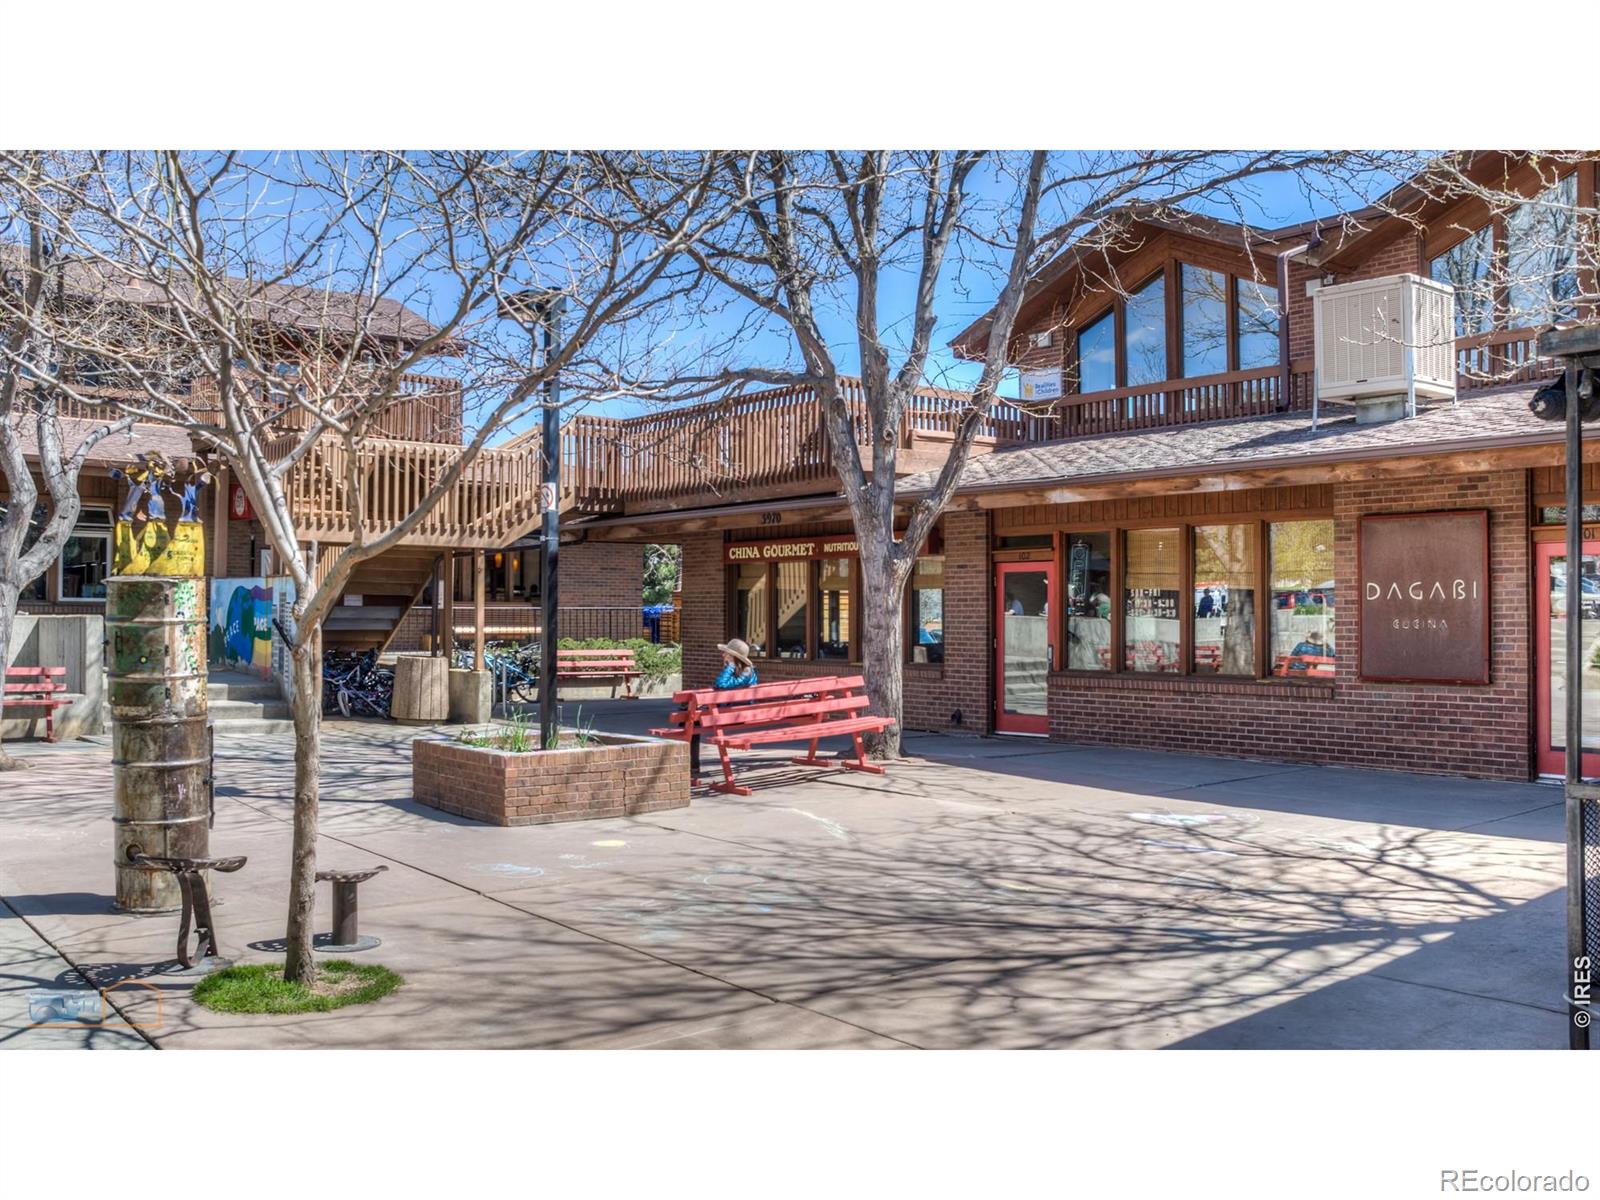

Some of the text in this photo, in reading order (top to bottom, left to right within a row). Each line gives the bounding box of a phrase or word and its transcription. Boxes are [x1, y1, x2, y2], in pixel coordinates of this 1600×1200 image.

[1583, 528, 1595, 540] 01
[729, 541, 859, 559] CHINA GOURMET NUTRITIOU
[1366, 579, 1478, 600] DAGABI
[1392, 619, 1448, 630] CUCINA
